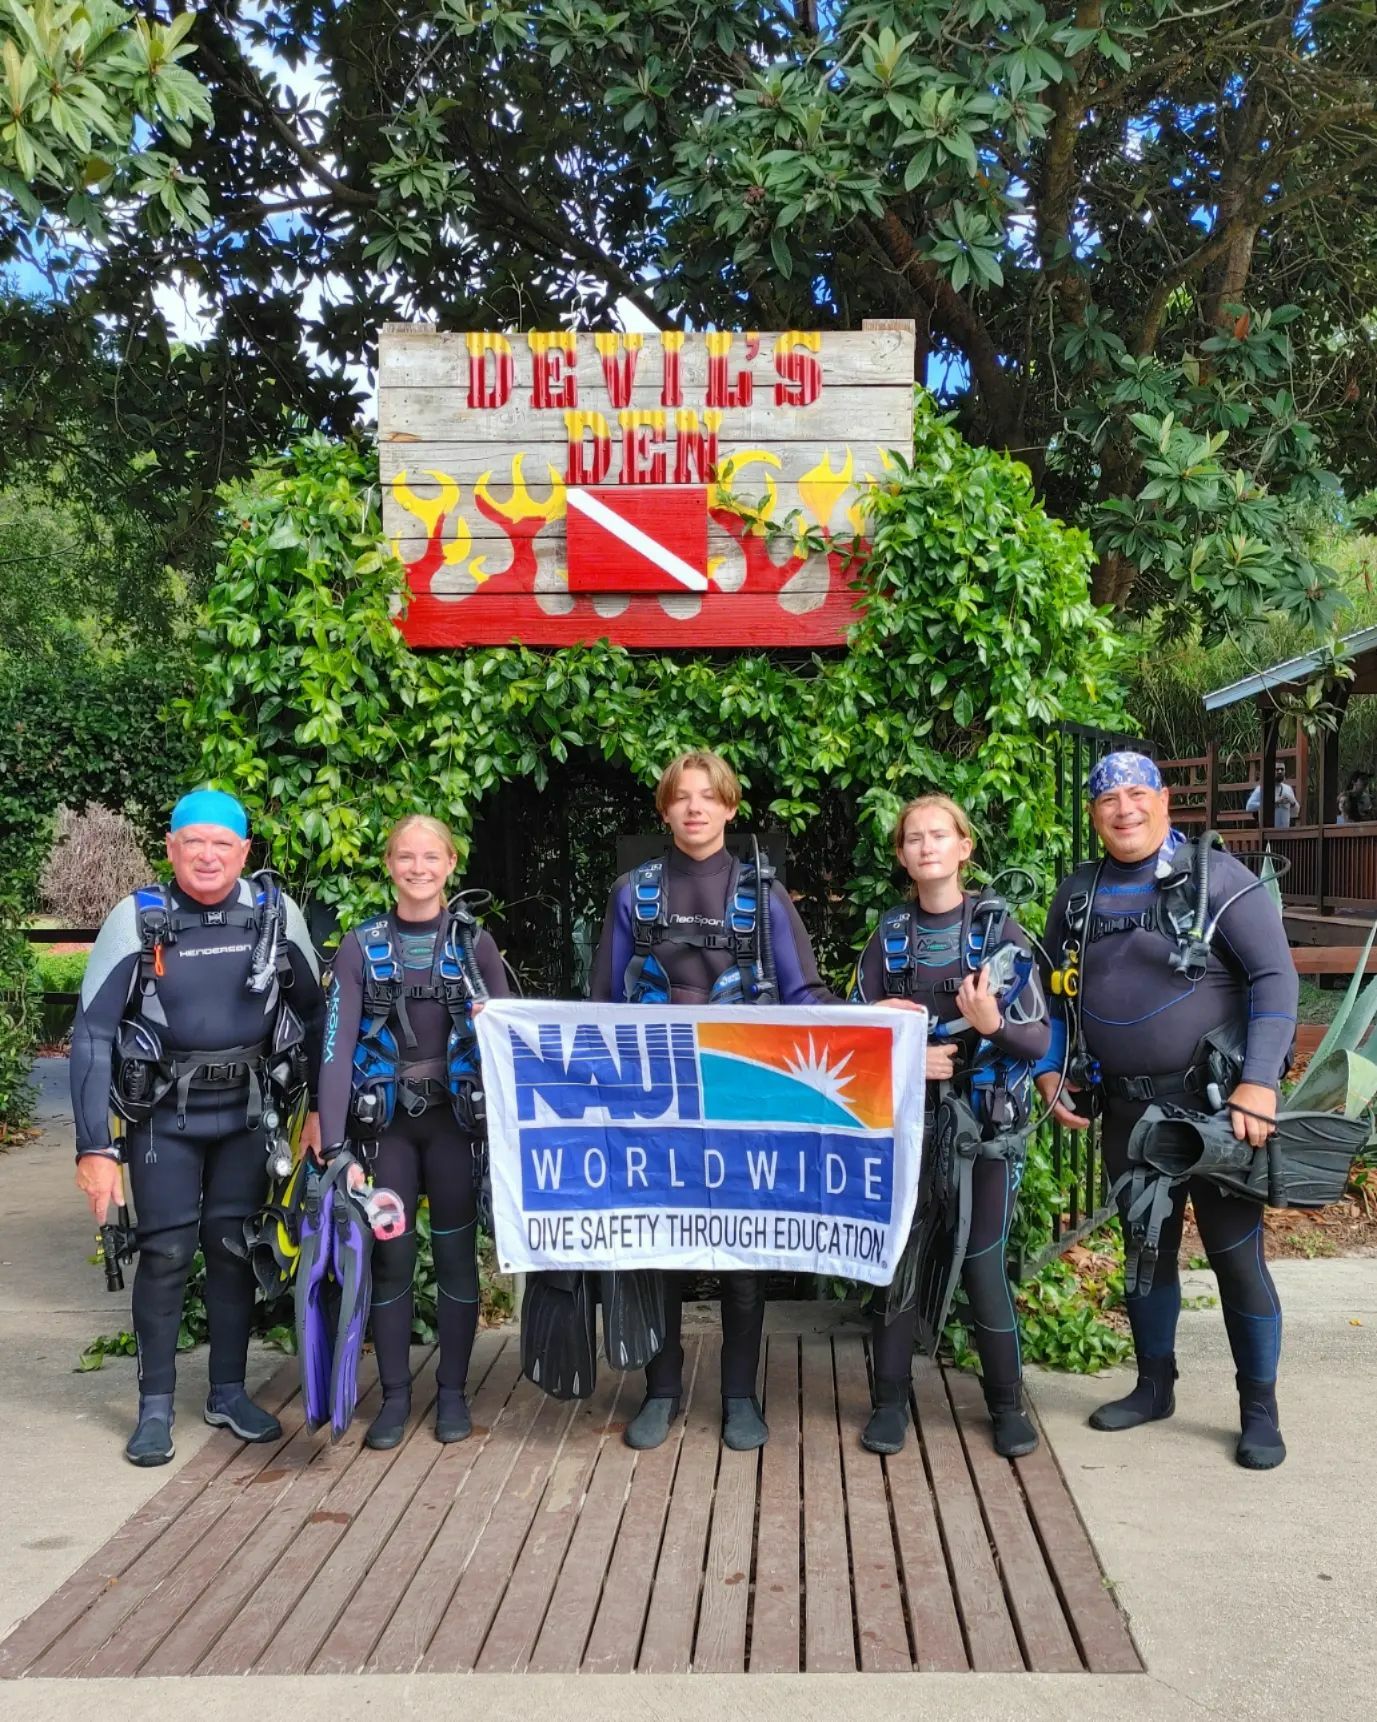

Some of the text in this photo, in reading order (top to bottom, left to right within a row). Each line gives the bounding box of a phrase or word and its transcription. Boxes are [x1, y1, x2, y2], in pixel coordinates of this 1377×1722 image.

[466, 330, 823, 409] DEVIL'S
[563, 410, 723, 485] DEN
[179, 944, 253, 957] HENDERSON
[508, 1023, 699, 1121] NAUI
[527, 1213, 886, 1264] DIVE SAFETY THROUGH EDUCATION
